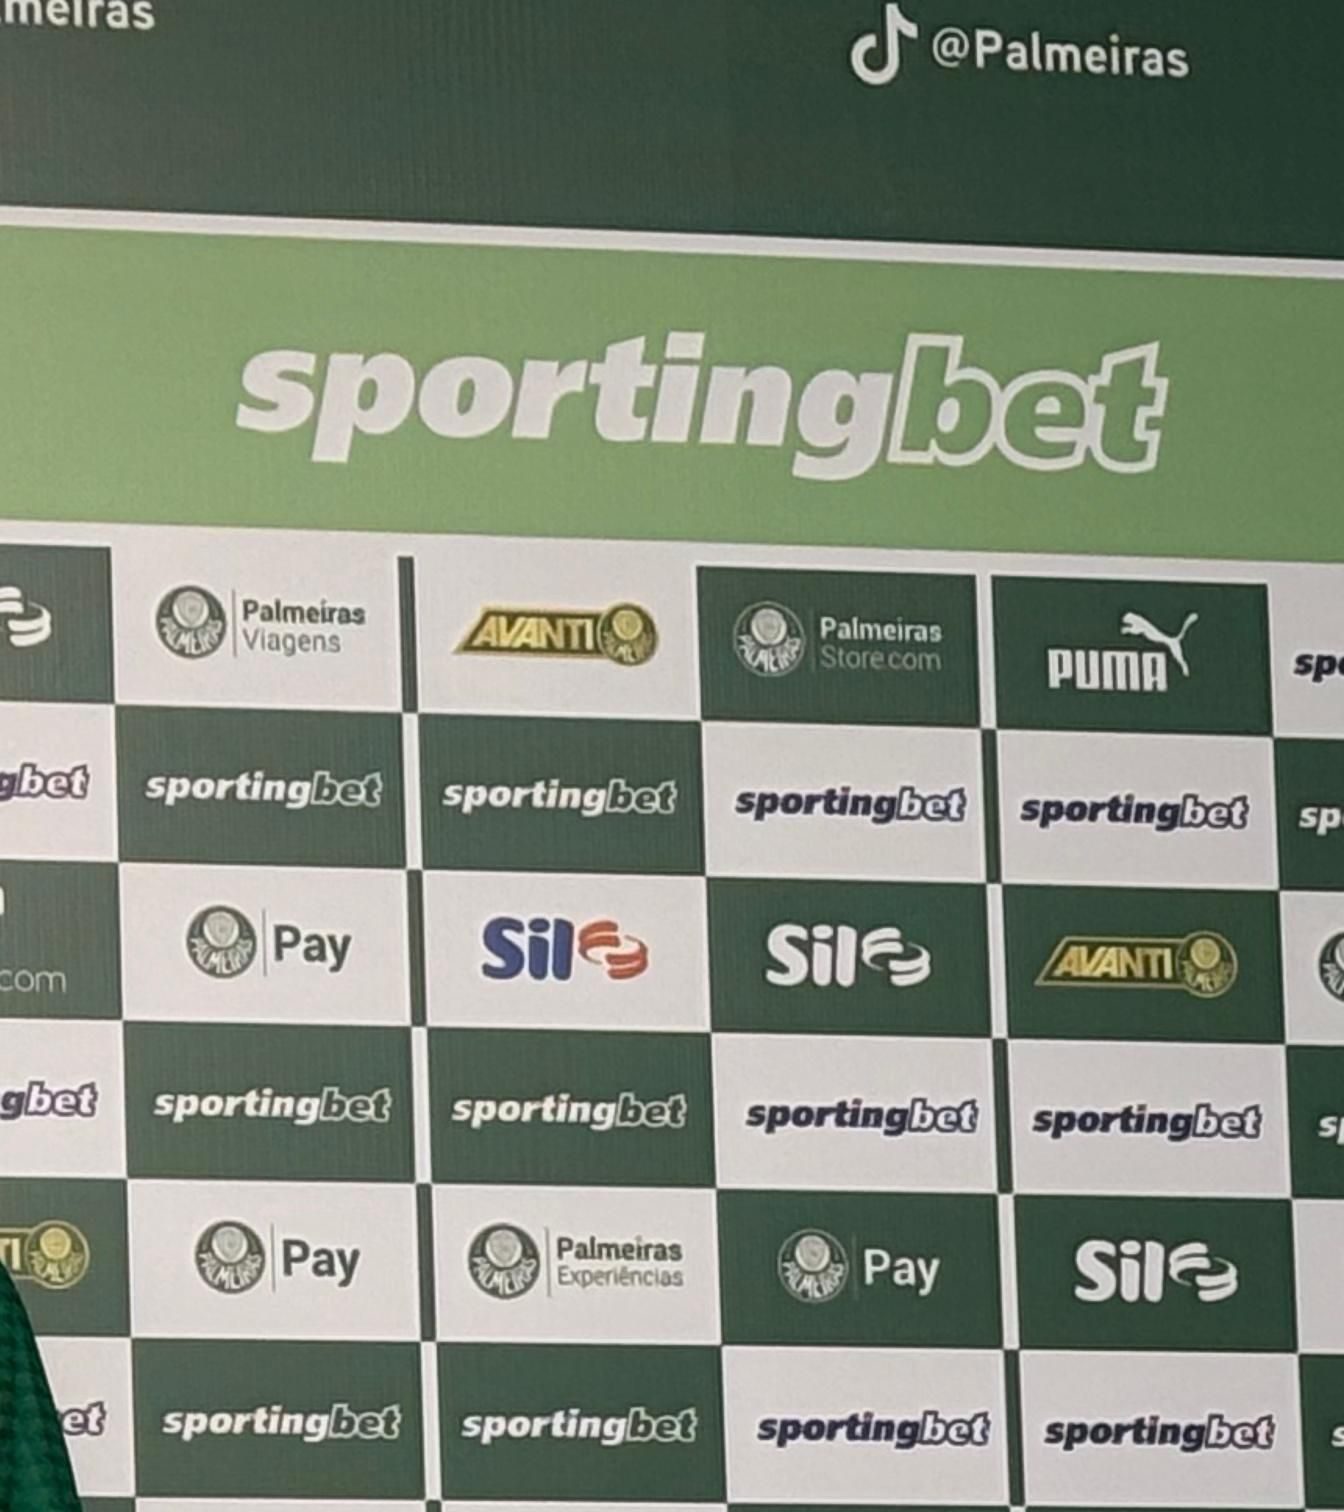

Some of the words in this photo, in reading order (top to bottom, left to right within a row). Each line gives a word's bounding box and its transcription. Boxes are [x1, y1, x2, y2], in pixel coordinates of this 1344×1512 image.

[933, 28, 1188, 77] @Palmeiras
[236, 332, 1168, 480] sportingbet
[243, 599, 365, 625] Palmeiras
[821, 617, 942, 642] Palmeiras
[243, 629, 341, 657] Viagens
[471, 616, 593, 649] AVANTI
[821, 645, 941, 670] Store.com
[1048, 649, 1167, 691] PUMA
[146, 771, 382, 809] sportingbet
[443, 779, 677, 816] sportingbet
[736, 786, 966, 824] sportingbet
[1021, 794, 1249, 832] sportingbet
[275, 925, 351, 972] Pay
[482, 917, 574, 980] Sil
[766, 924, 857, 987] Sil
[1052, 945, 1172, 978] AVANTI
[154, 1087, 391, 1125] sportingbet
[452, 1093, 687, 1130] sportingbet
[746, 1098, 978, 1136] sportingbet
[1033, 1103, 1262, 1142] sportingbet
[283, 1239, 360, 1287] Pay
[557, 1236, 682, 1261] Palmeiras
[558, 1265, 683, 1289] Experiências
[865, 1249, 939, 1296] Pay
[1075, 1240, 1164, 1302] Sil
[163, 1404, 401, 1442] sportingbet
[462, 1407, 697, 1445] sportingbet
[758, 1410, 990, 1449] sportingbet
[1045, 1414, 1275, 1452] sportingbet
